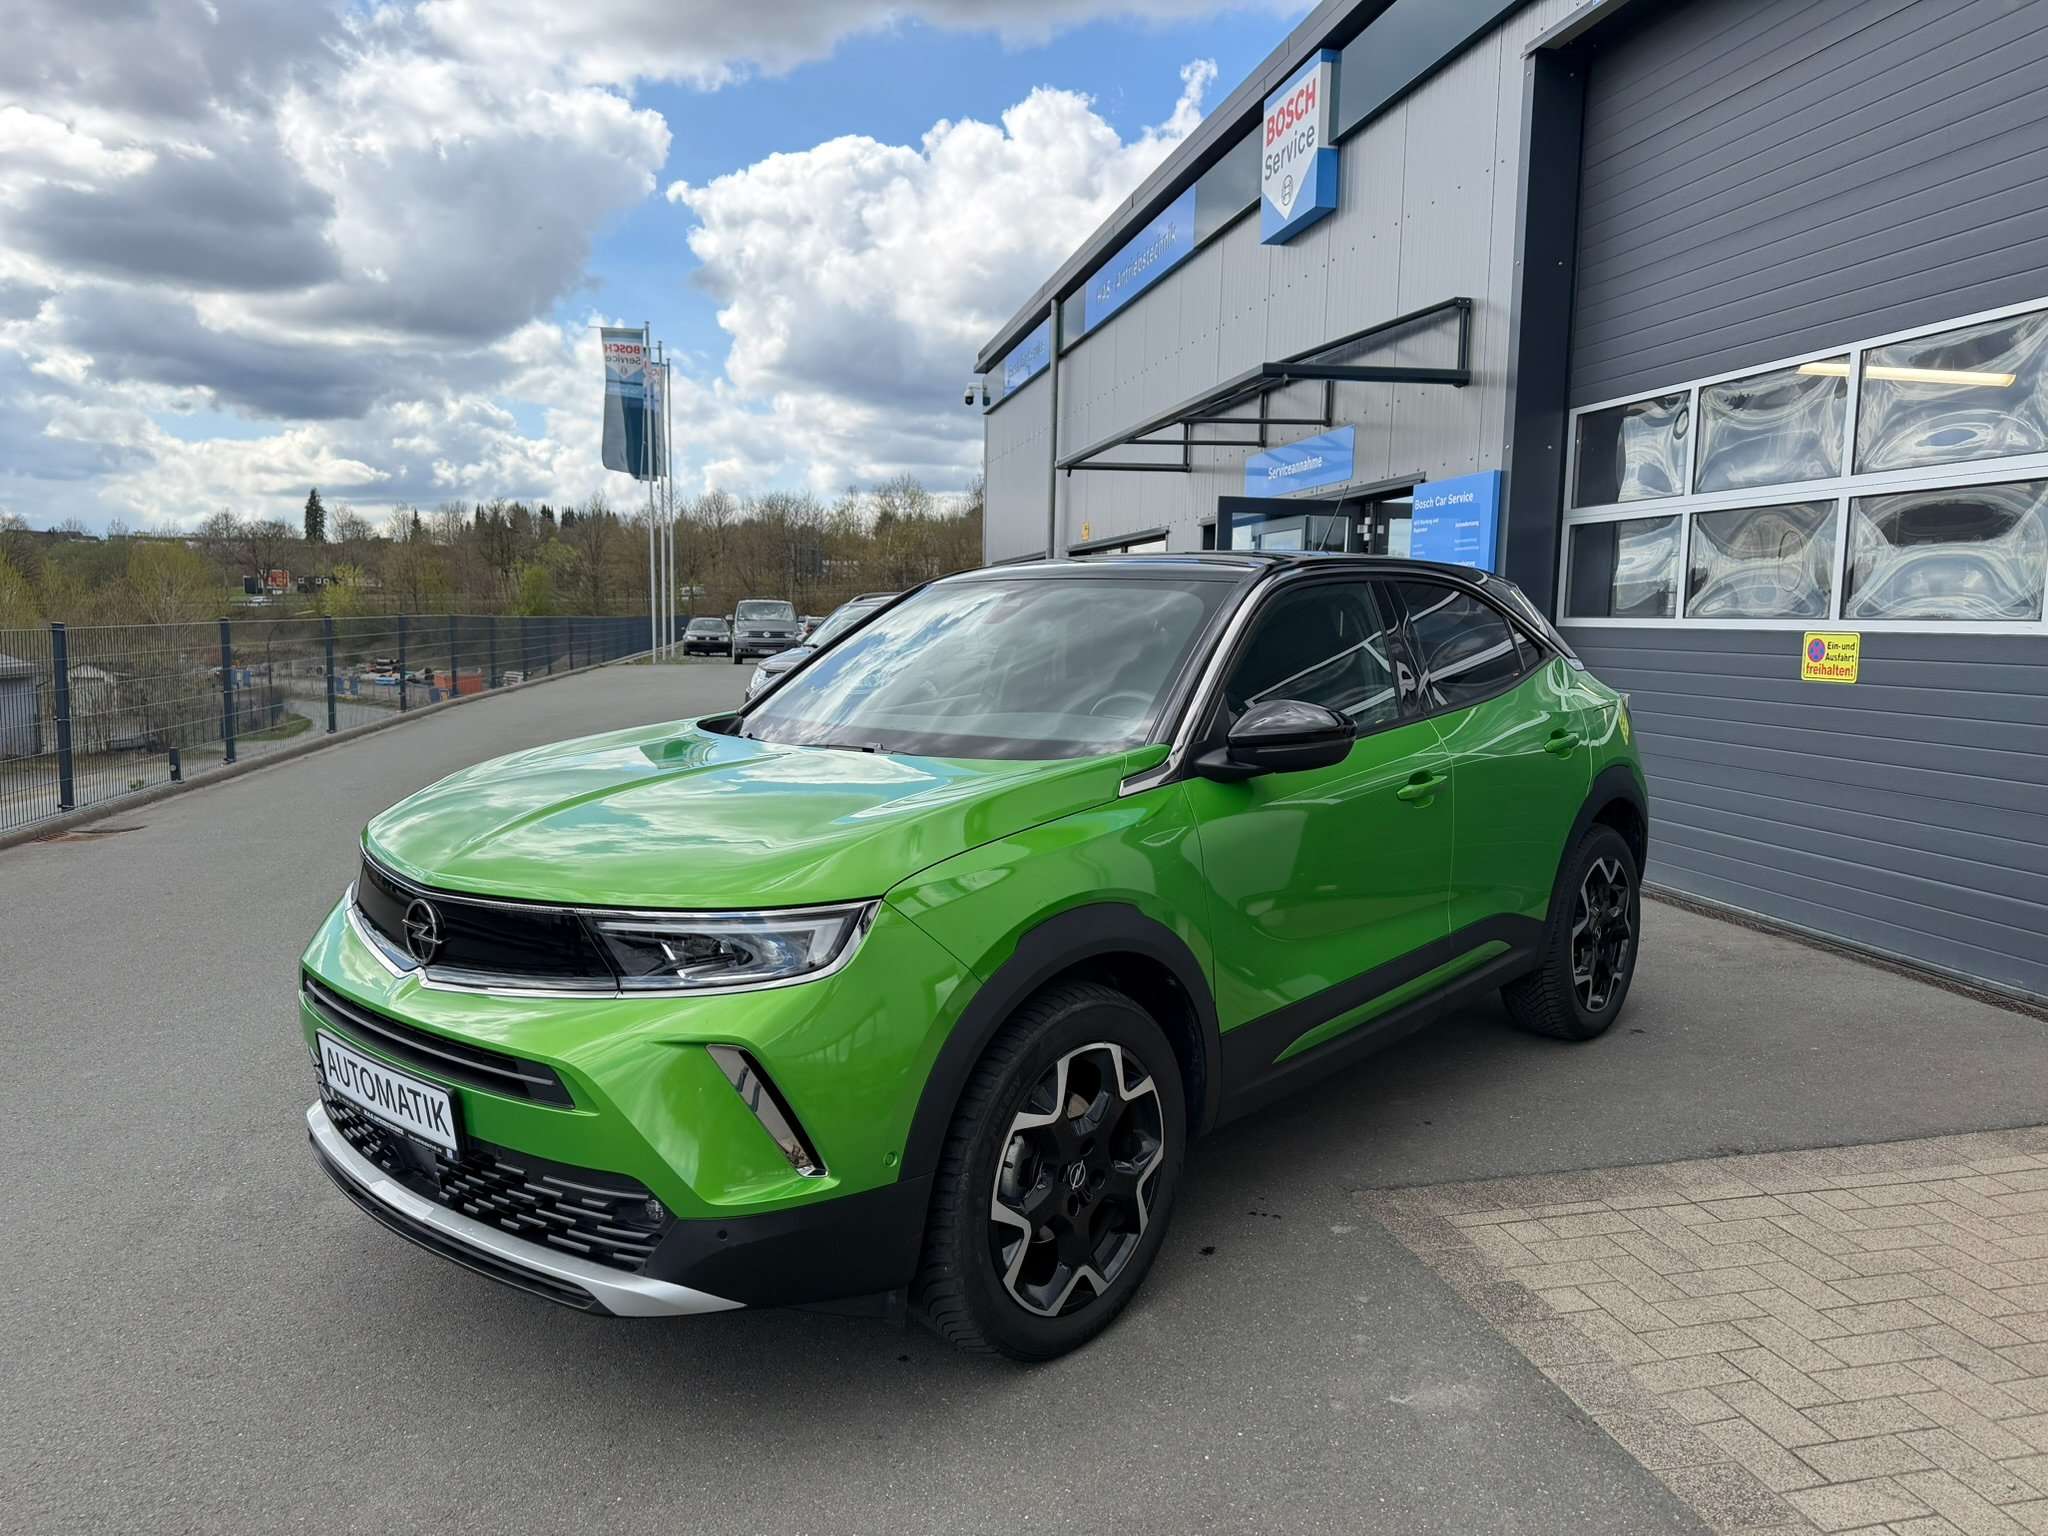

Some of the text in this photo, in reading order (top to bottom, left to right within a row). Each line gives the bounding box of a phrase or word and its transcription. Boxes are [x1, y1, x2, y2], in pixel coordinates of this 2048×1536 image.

[1266, 78, 1316, 147] BOSCH
[1264, 125, 1315, 181] Service
[1415, 491, 1473, 511] Bosch Car Service
[1806, 662, 1854, 677] freihalten!
[1825, 652, 1855, 662] Ausfahrt
[327, 1047, 451, 1137] AUTOMATIK
